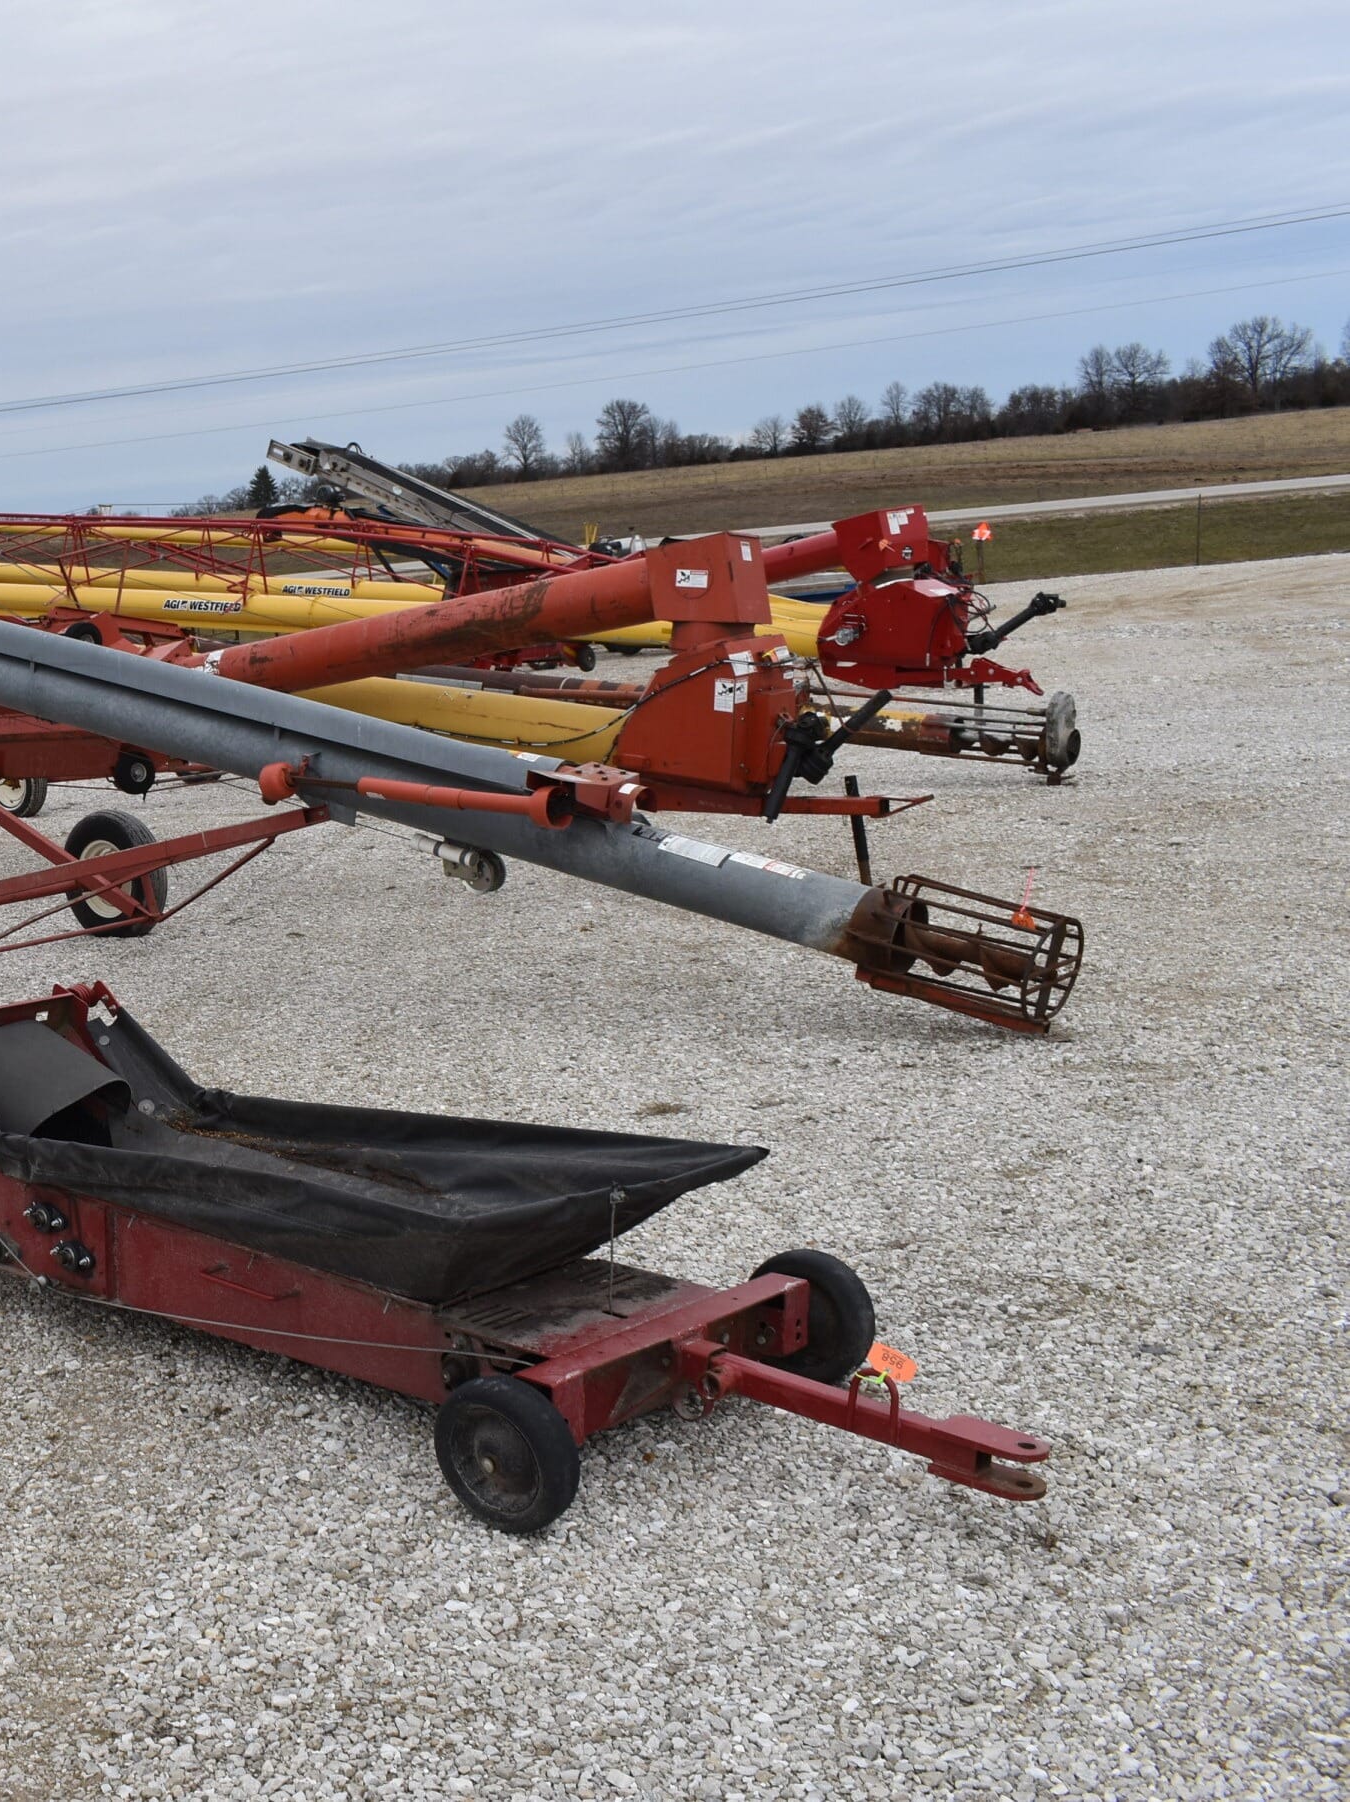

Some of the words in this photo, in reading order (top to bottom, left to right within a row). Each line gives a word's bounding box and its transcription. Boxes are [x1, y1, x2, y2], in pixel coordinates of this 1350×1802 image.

[282, 585, 297, 594] AGI
[304, 586, 350, 597] WESTFIELD
[164, 600, 180, 609] AGI
[881, 1352, 903, 1370] 958
